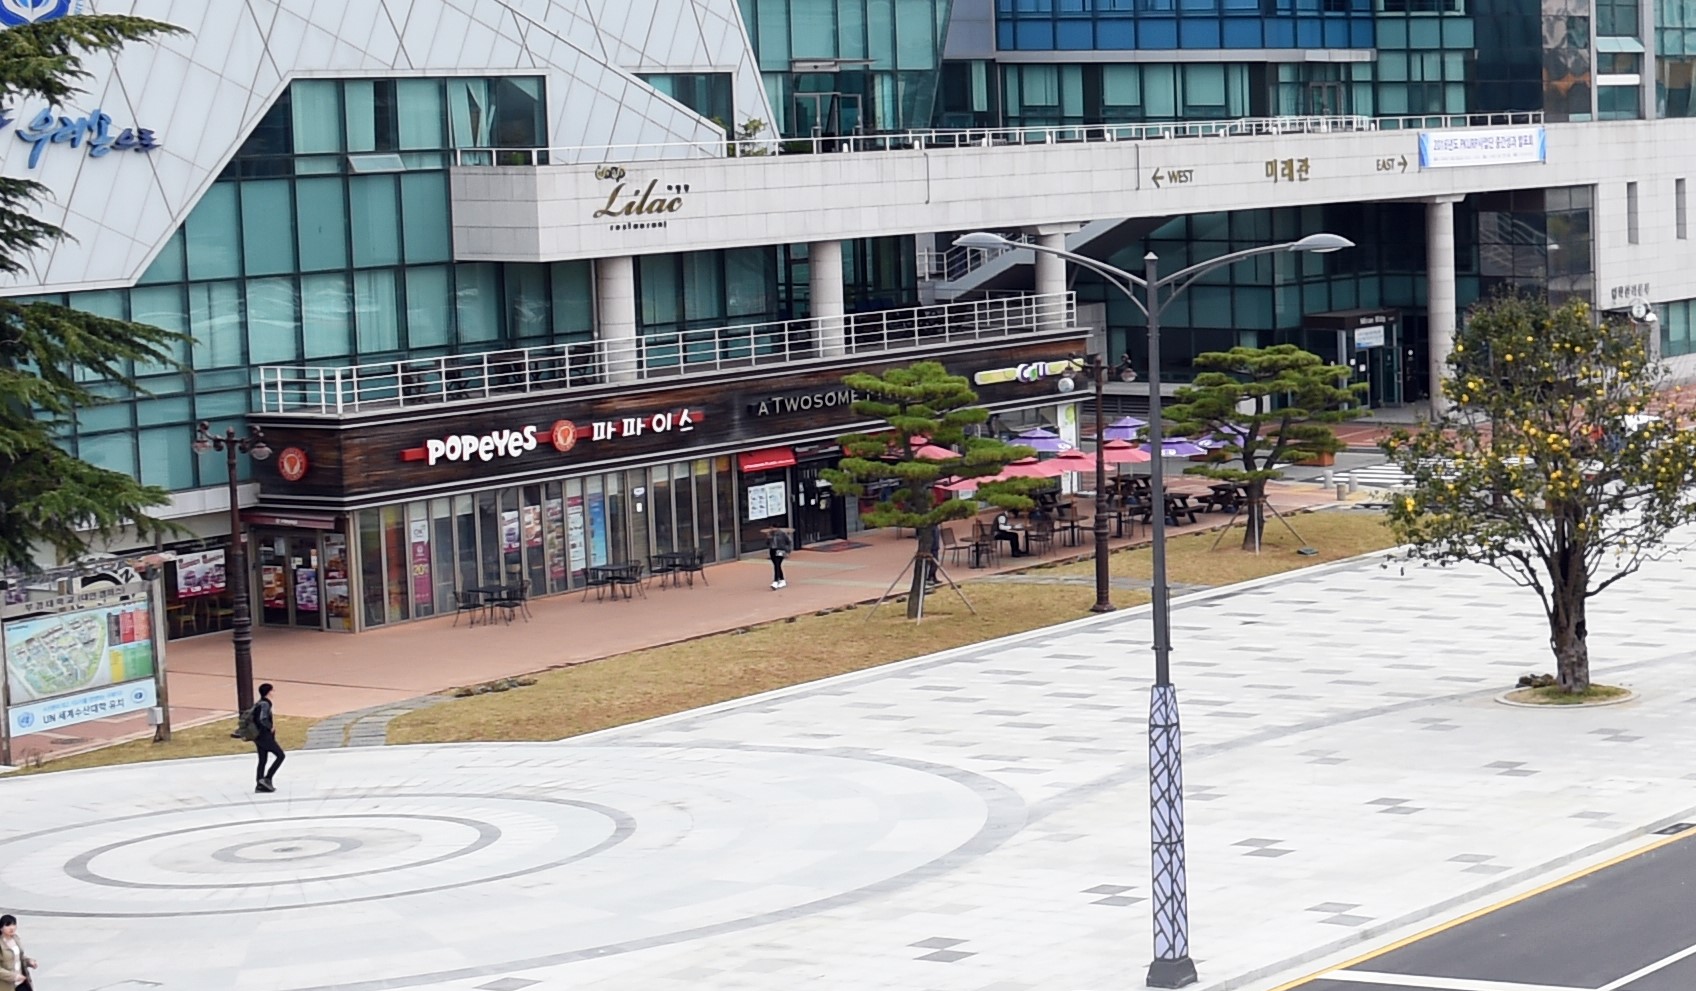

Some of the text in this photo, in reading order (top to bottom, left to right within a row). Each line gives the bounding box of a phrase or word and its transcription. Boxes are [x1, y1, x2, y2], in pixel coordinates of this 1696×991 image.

[1167, 169, 1194, 184] WEST
[1265, 157, 1311, 183] 미래관
[1376, 158, 1395, 171] EAST
[593, 178, 682, 218] Lilac
[758, 401, 769, 416] A
[772, 389, 859, 414] TWOSOME
[592, 409, 695, 441] 파파이스
[43, 714, 56, 724] UN
